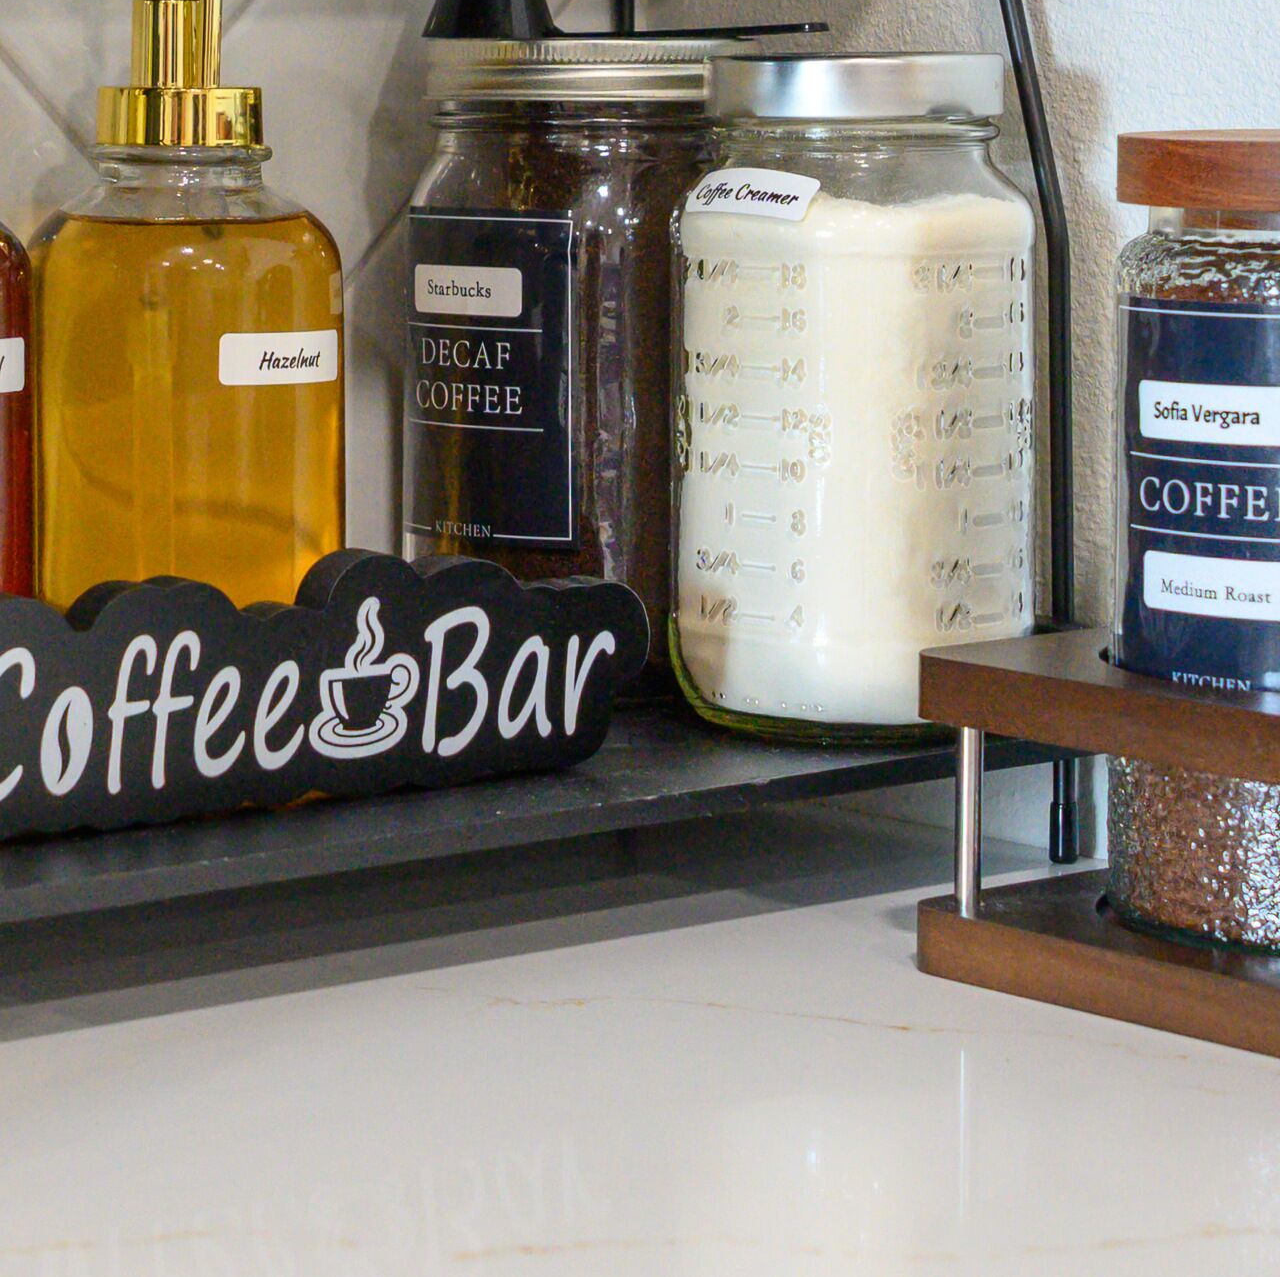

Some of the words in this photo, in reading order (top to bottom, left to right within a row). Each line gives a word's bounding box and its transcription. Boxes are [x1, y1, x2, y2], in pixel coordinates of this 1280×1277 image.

[696, 182, 734, 206] Coffee
[735, 183, 800, 206] Creamer
[427, 278, 492, 299] Starbucks
[258, 348, 322, 372] Hazelnut
[420, 337, 511, 370] DECAF
[415, 379, 524, 416] COFFEE
[1153, 400, 1189, 421] Sofia
[1192, 403, 1261, 430] Vergara
[434, 520, 492, 539] KITCHEN
[1160, 577, 1218, 601] Medium
[1224, 585, 1271, 605] Roast
[422, 605, 616, 757] Bar
